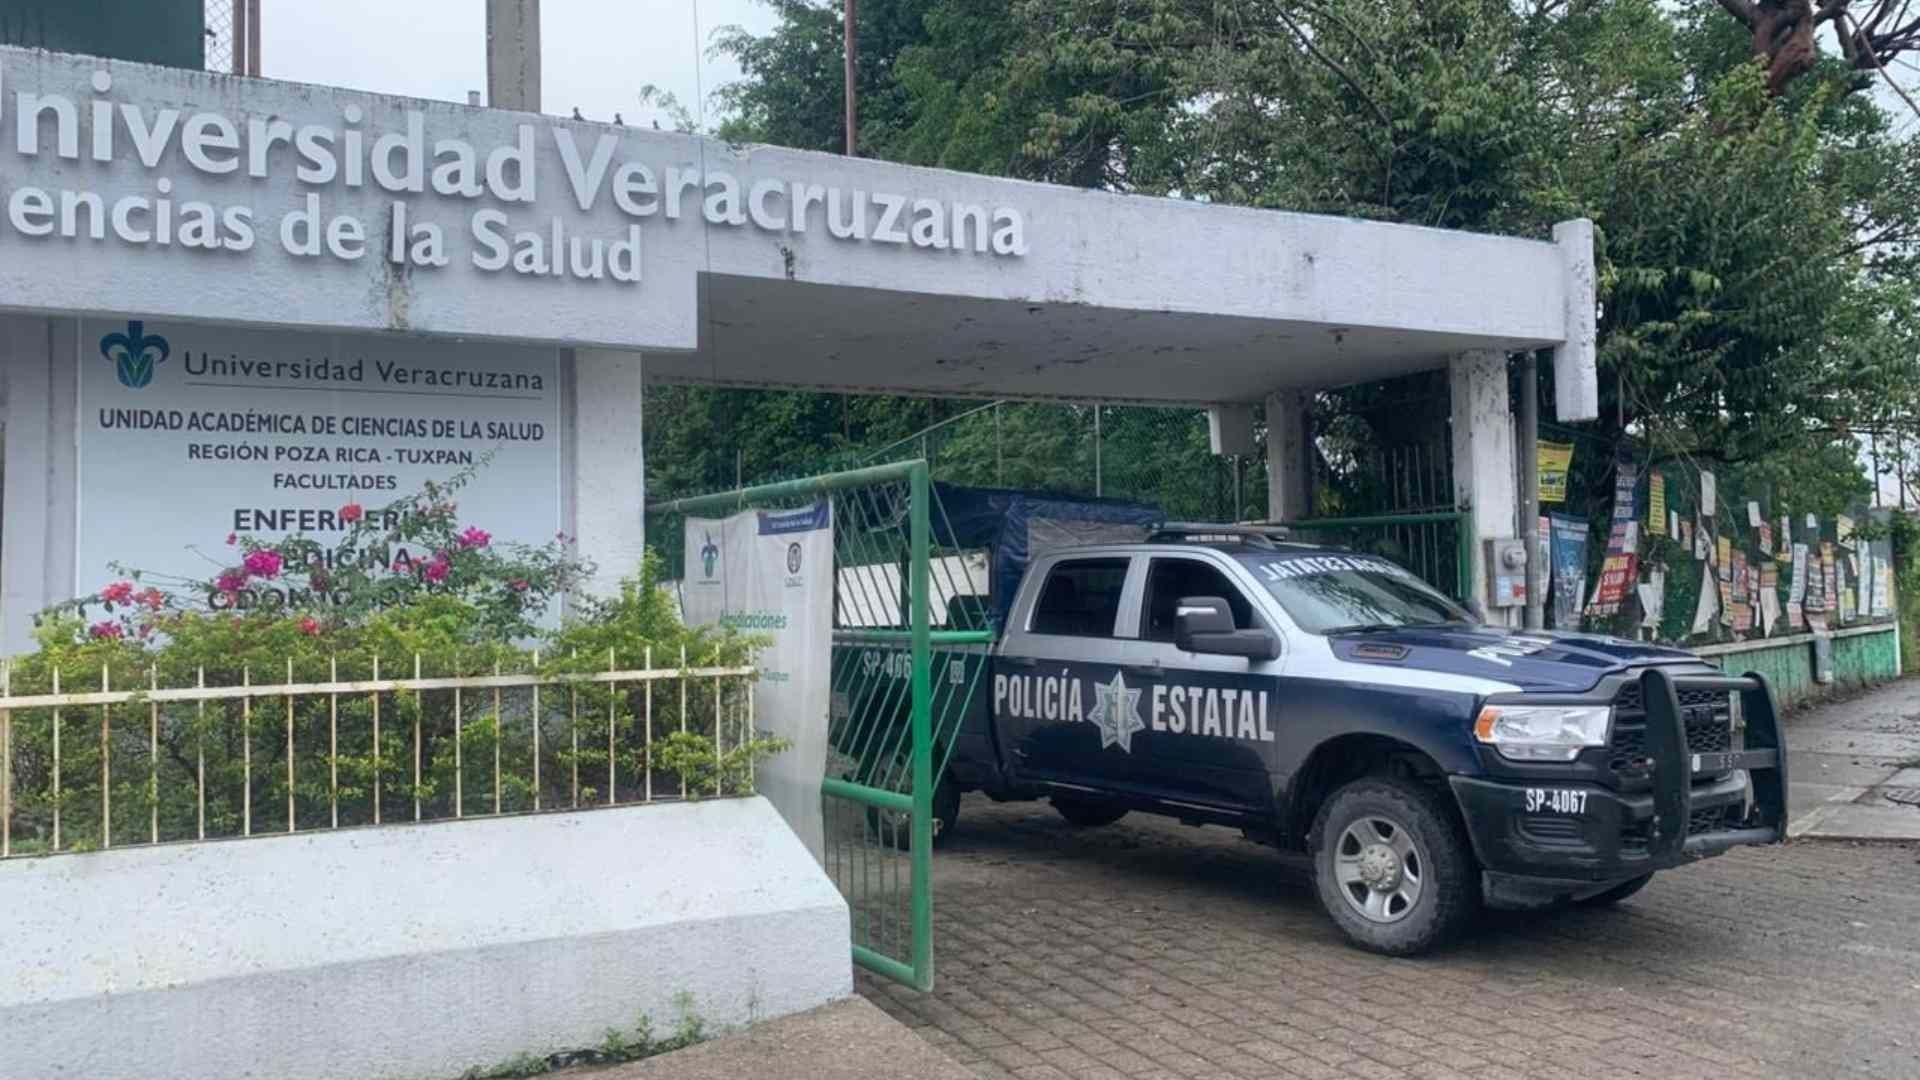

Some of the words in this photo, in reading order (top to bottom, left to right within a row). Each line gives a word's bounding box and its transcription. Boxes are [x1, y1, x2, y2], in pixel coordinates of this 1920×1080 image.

[0, 66, 534, 201] niversidad
[553, 127, 1026, 256] Veracruzana
[280, 193, 366, 260] de
[391, 203, 449, 267] la
[471, 208, 643, 283] Salud
[184, 351, 364, 382] Universidad
[376, 359, 544, 390] Veracruzana
[100, 408, 183, 431] UNIDAD
[187, 408, 306, 434] ACADÉMICA
[311, 415, 337, 435] DE
[341, 416, 428, 438] CIENCIAS
[432, 419, 456, 439] DE
[460, 420, 483, 440] LA
[487, 421, 545, 442] SALUD
[188, 440, 269, 461] REGIÓN
[275, 445, 330, 462] POZA
[336, 447, 382, 463] RICA
[395, 448, 473, 465] TUXPAN
[274, 472, 398, 490] FACULTADES
[863, 650, 914, 681] SP-406
[993, 667, 1085, 723] POLICÍA
[1151, 684, 1275, 742] ESTATAL
[1525, 787, 1588, 815] SP-4067
